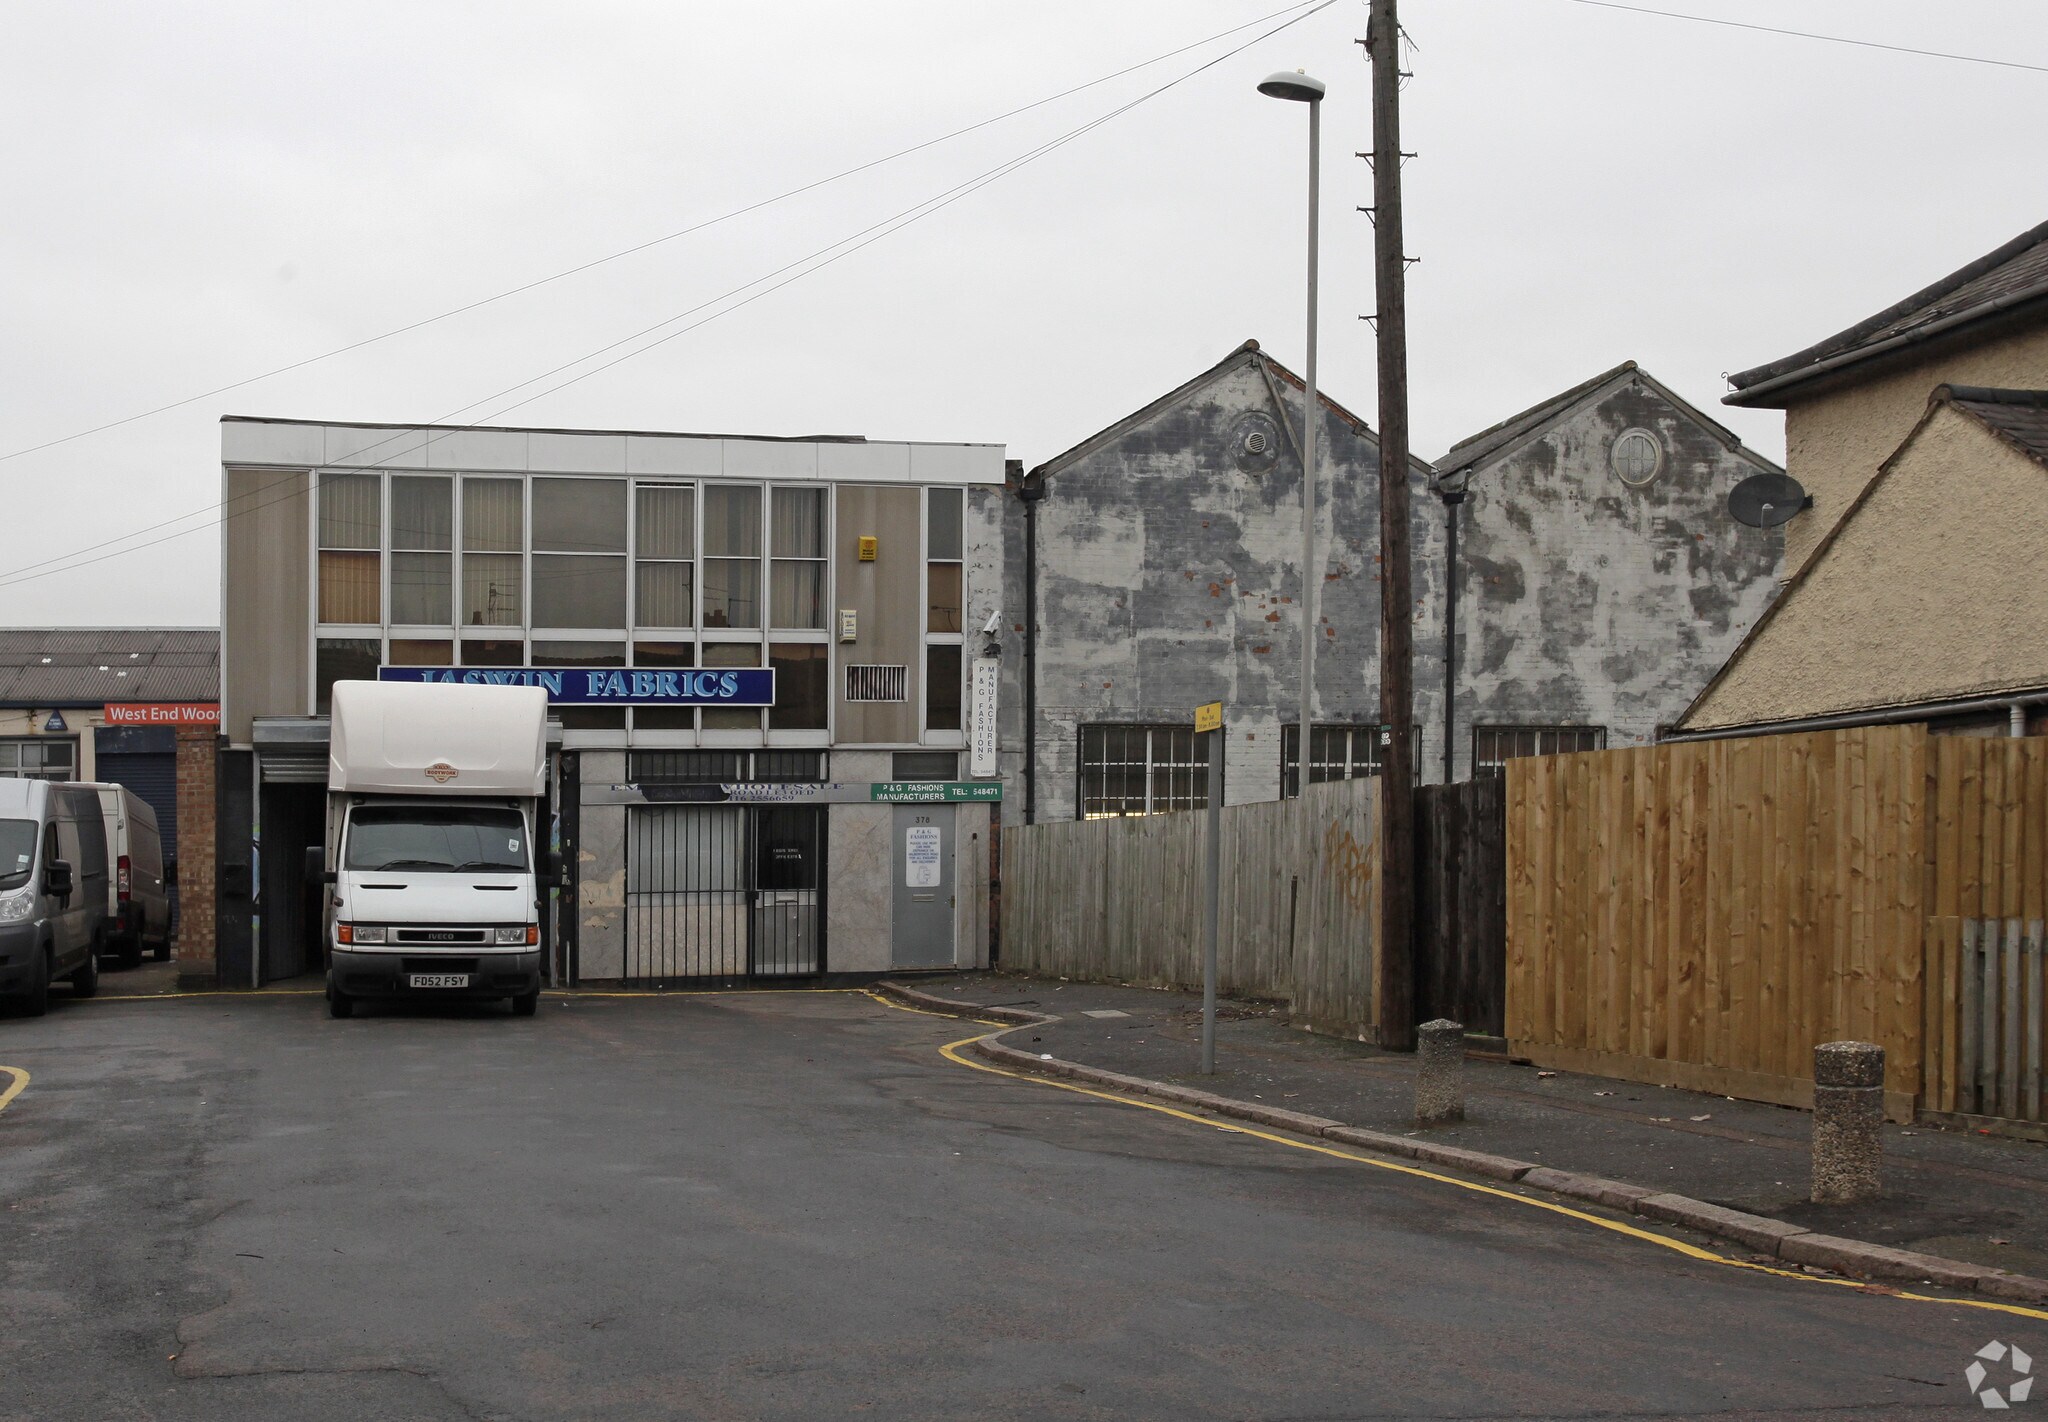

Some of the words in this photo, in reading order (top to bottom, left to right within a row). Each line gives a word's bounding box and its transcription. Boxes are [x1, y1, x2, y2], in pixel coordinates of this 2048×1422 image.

[586, 670, 739, 697] FABRICS
[978, 688, 984, 696] G
[110, 707, 147, 720] West
[151, 706, 179, 720] End
[182, 707, 221, 720] Woo
[987, 667, 995, 754] MANUFACTURER
[896, 784, 902, 792] G
[907, 784, 944, 792] FASHIONS
[915, 816, 930, 824] 378
[414, 976, 441, 986] FD52
[444, 976, 465, 986] FSY
